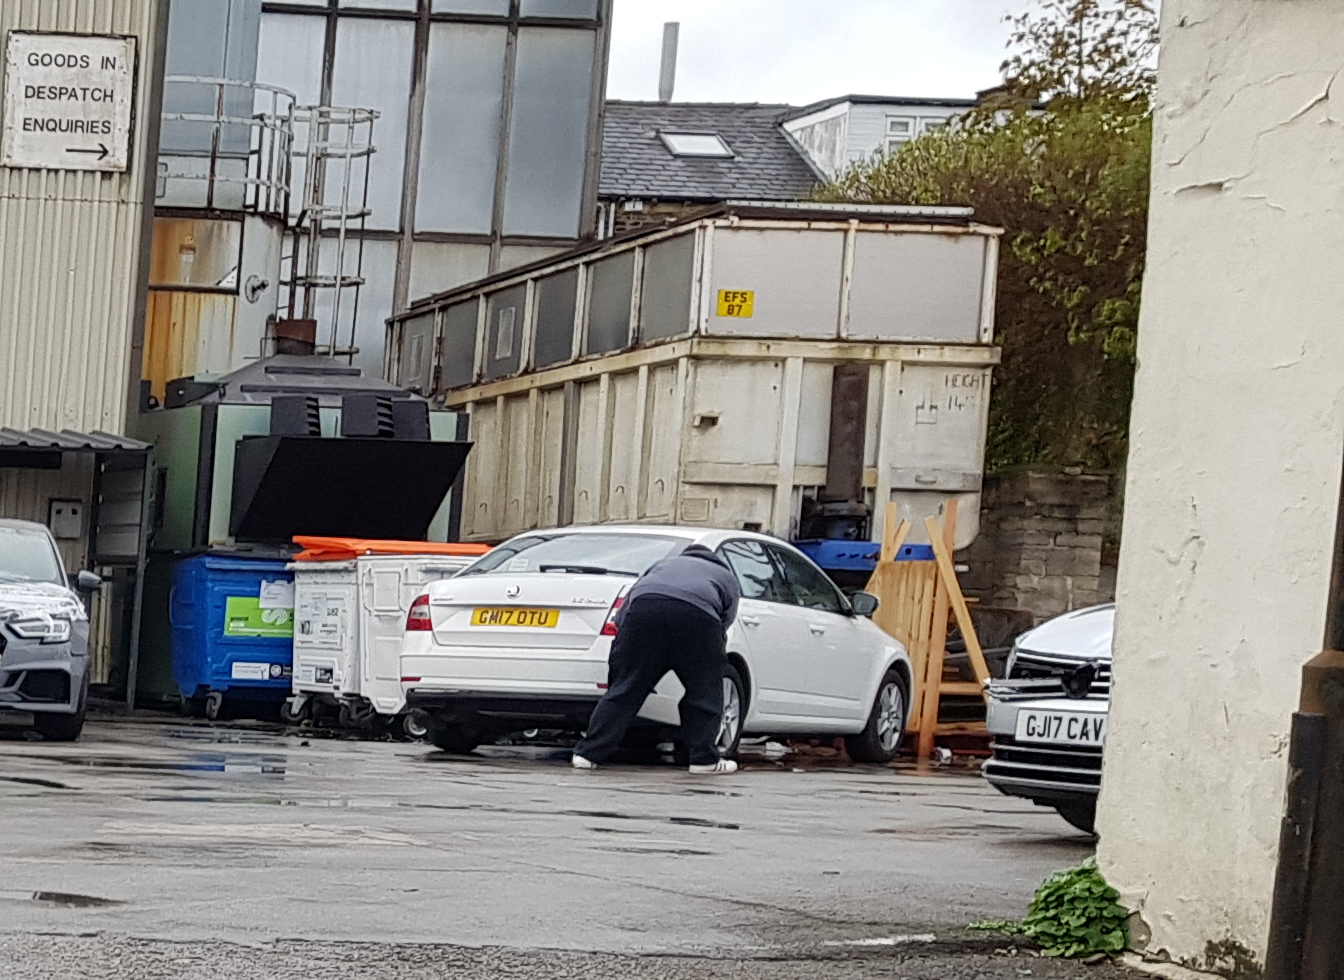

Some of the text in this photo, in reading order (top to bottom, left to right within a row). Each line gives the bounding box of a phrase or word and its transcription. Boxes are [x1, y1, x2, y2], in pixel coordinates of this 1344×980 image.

[27, 52, 117, 70] GOODS IN
[24, 84, 115, 103] DESPATCH
[22, 117, 112, 134] ENQUIRIES
[724, 291, 748, 303] EFS
[945, 372, 989, 388] HEIGHT
[516, 610, 549, 625] OTU
[1026, 714, 1104, 742] GJ17 CAV
